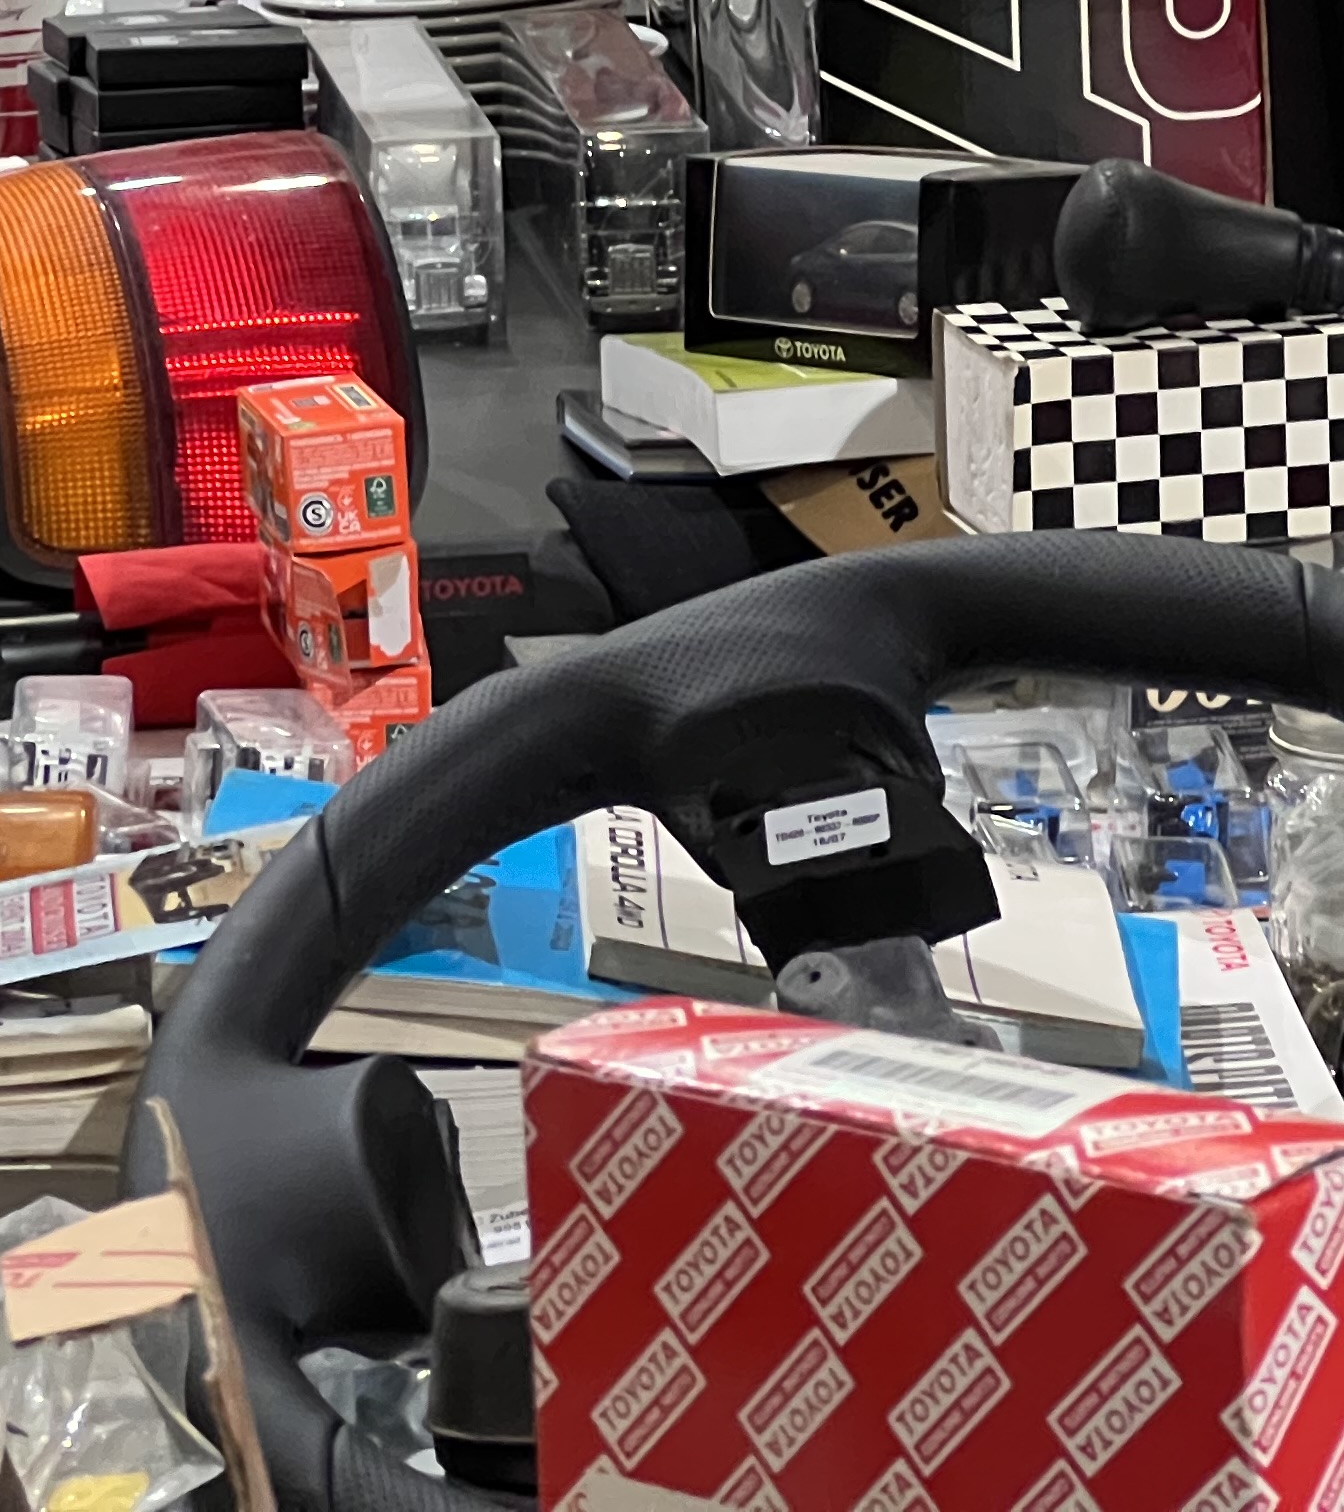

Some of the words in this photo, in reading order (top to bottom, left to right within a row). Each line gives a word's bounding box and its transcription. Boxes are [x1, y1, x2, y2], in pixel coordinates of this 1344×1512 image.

[794, 341, 846, 362] TOYOTA
[855, 462, 919, 534] SER
[419, 575, 523, 602] TOYOTA
[1203, 919, 1250, 972] TOYOTA
[592, 1114, 680, 1208] TOYOTA
[531, 1238, 615, 1333] TOYOTA
[664, 1213, 744, 1307] TOYOTA
[828, 1237, 914, 1331] TOYOTA
[968, 1205, 1061, 1305] TOYOTA
[1152, 1220, 1251, 1328] TOYOTA
[598, 1340, 682, 1433] TOYOTA
[765, 1366, 847, 1460] TOYOTA
[895, 1340, 985, 1436] TOYOTA
[1074, 1366, 1174, 1463] TOYOTA
[1230, 1302, 1315, 1439] TOYOTA
